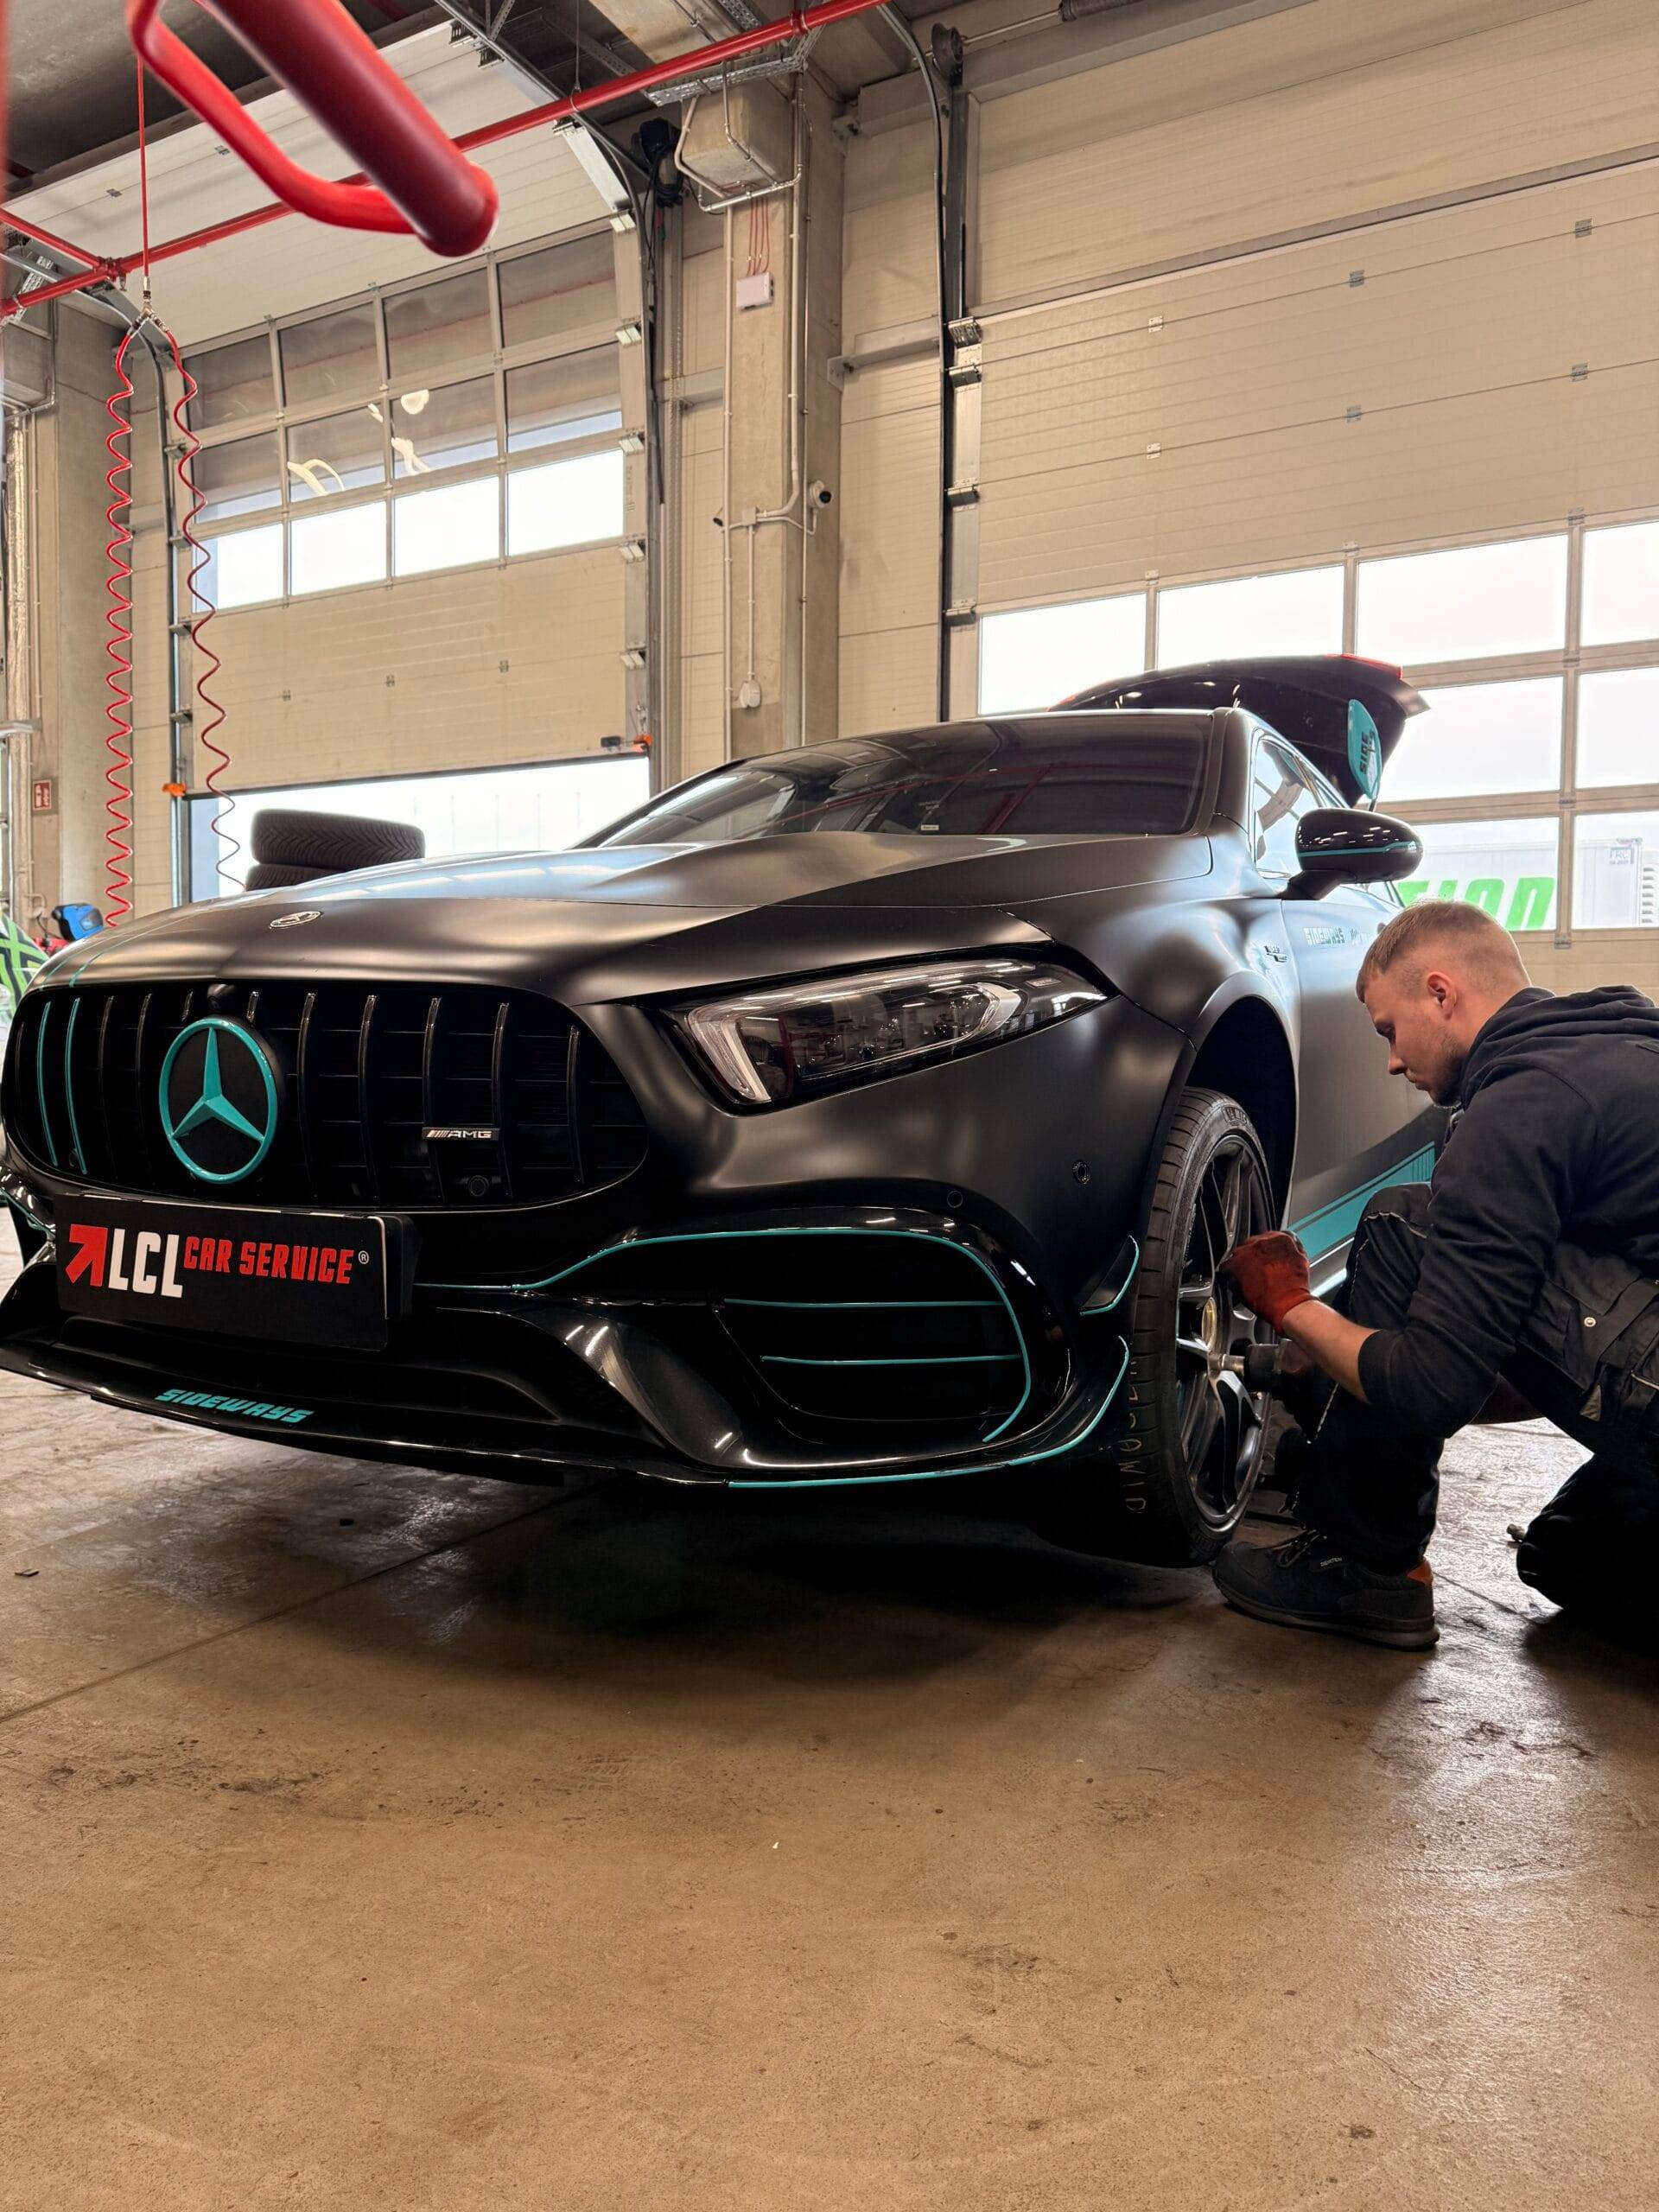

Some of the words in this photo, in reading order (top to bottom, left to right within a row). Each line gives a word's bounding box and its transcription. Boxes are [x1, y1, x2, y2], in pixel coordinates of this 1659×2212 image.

[447, 1130, 493, 1139] AMG
[108, 1228, 183, 1298] LCL
[183, 1236, 233, 1273] CAR
[238, 1242, 354, 1284] SERVICE
[155, 1389, 315, 1423] SIDEWAYS
